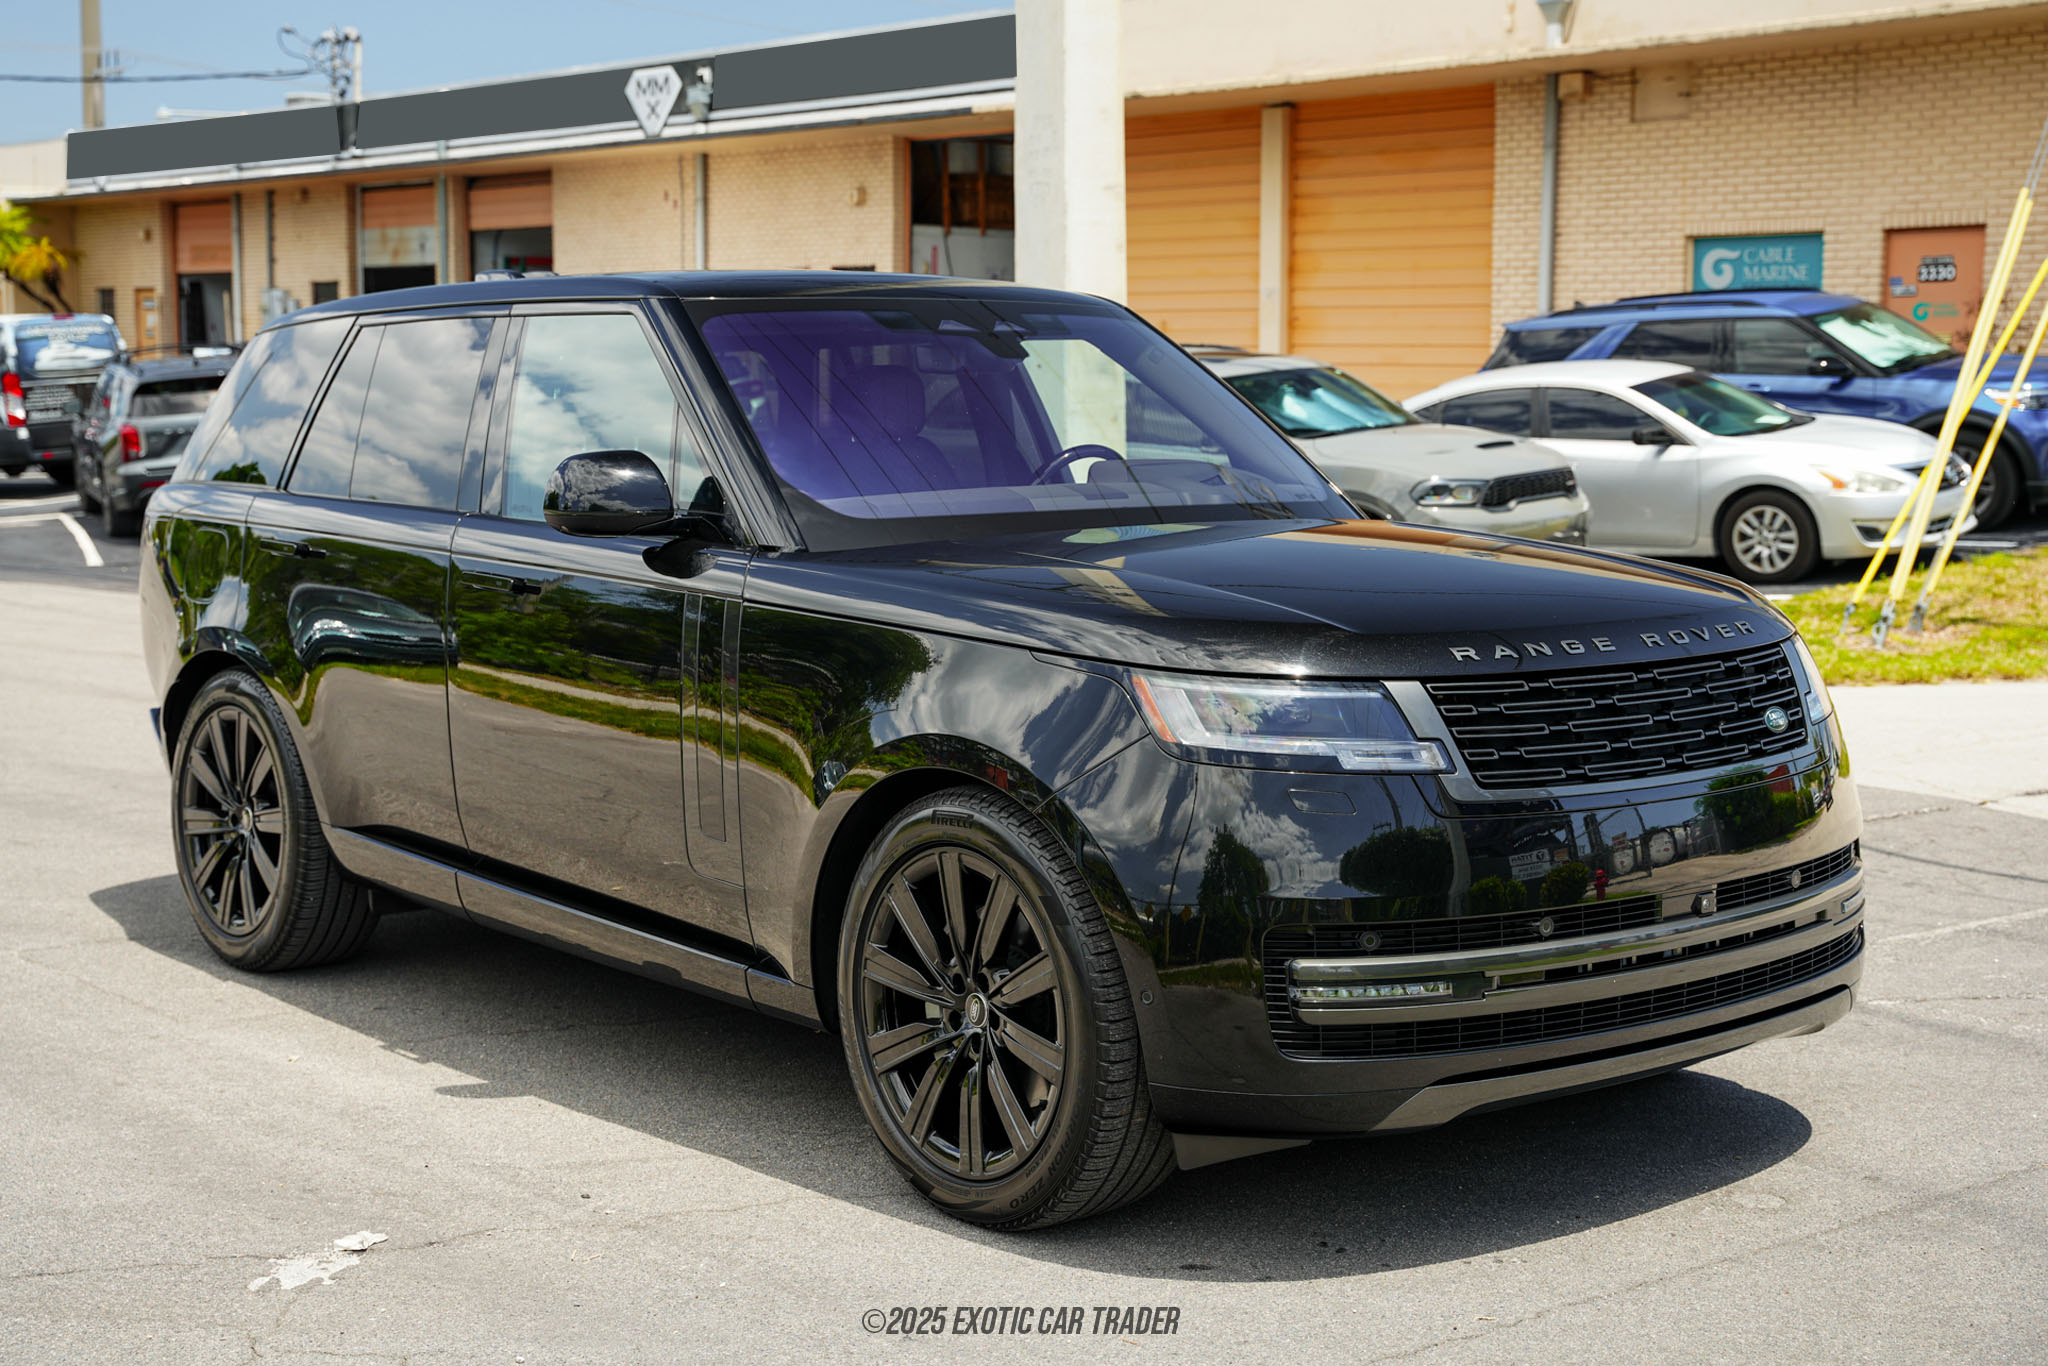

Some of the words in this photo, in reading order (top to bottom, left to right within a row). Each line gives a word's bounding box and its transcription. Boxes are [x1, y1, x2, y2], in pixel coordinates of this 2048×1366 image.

[1743, 264, 1809, 281] MARINE
[1448, 636, 1617, 662] RANGE
[1639, 620, 1756, 648] ROVER
[931, 809, 974, 829] PIRELLI
